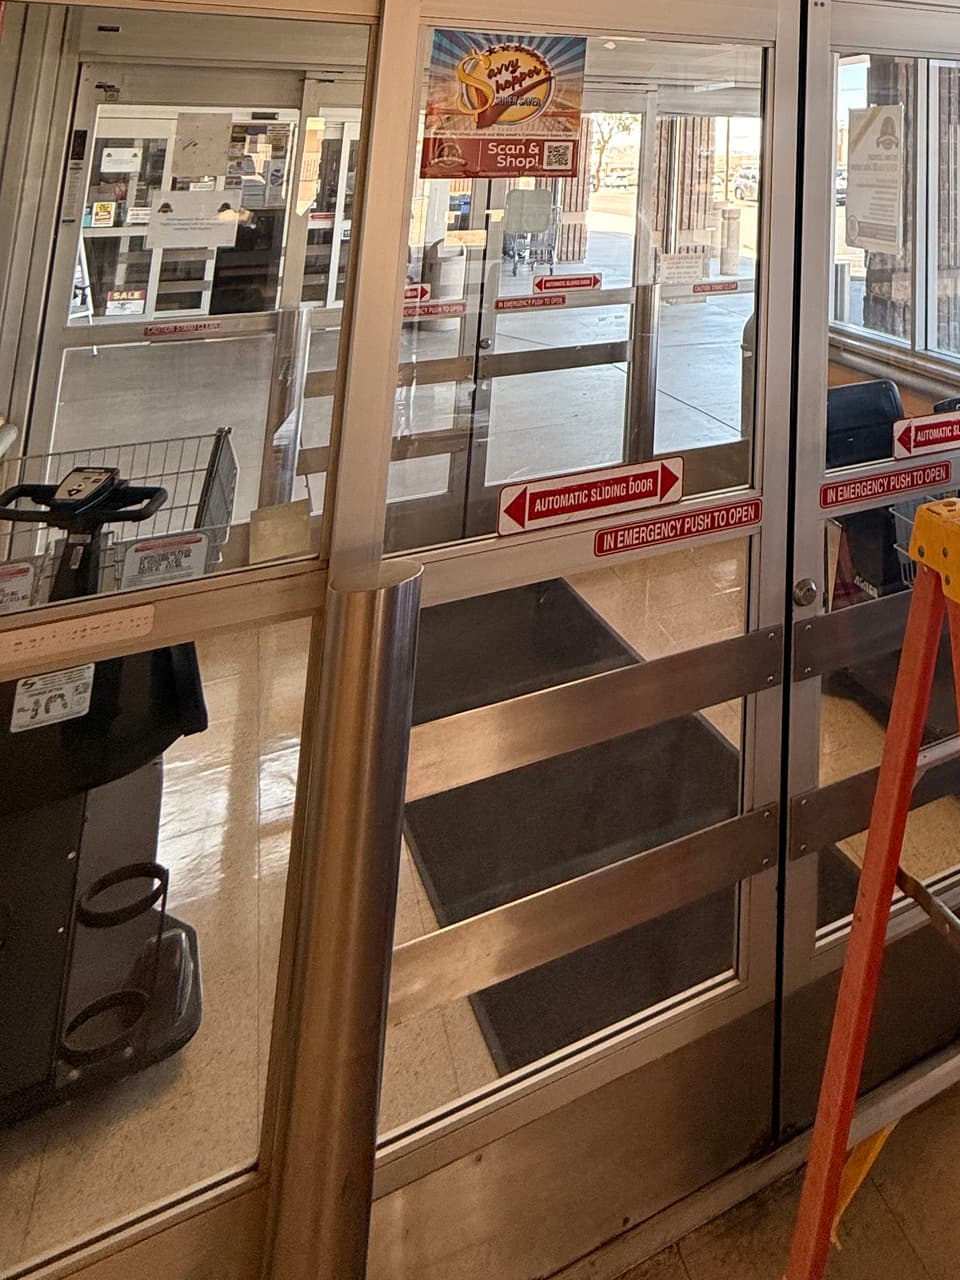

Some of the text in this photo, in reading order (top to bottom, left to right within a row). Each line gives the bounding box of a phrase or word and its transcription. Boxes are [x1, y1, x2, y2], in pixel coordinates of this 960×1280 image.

[488, 142, 540, 154] Scan &
[497, 155, 539, 169] Shop!
[113, 291, 141, 300] SALE
[916, 426, 952, 443] AUTOMATIC
[827, 466, 946, 503] IN EMERGENCY PUSH TO OPEN
[534, 478, 653, 513] AUTOMATIC SLIDING DOOR
[603, 505, 755, 550] IN EMERGENCY PUSH TO OPEN
